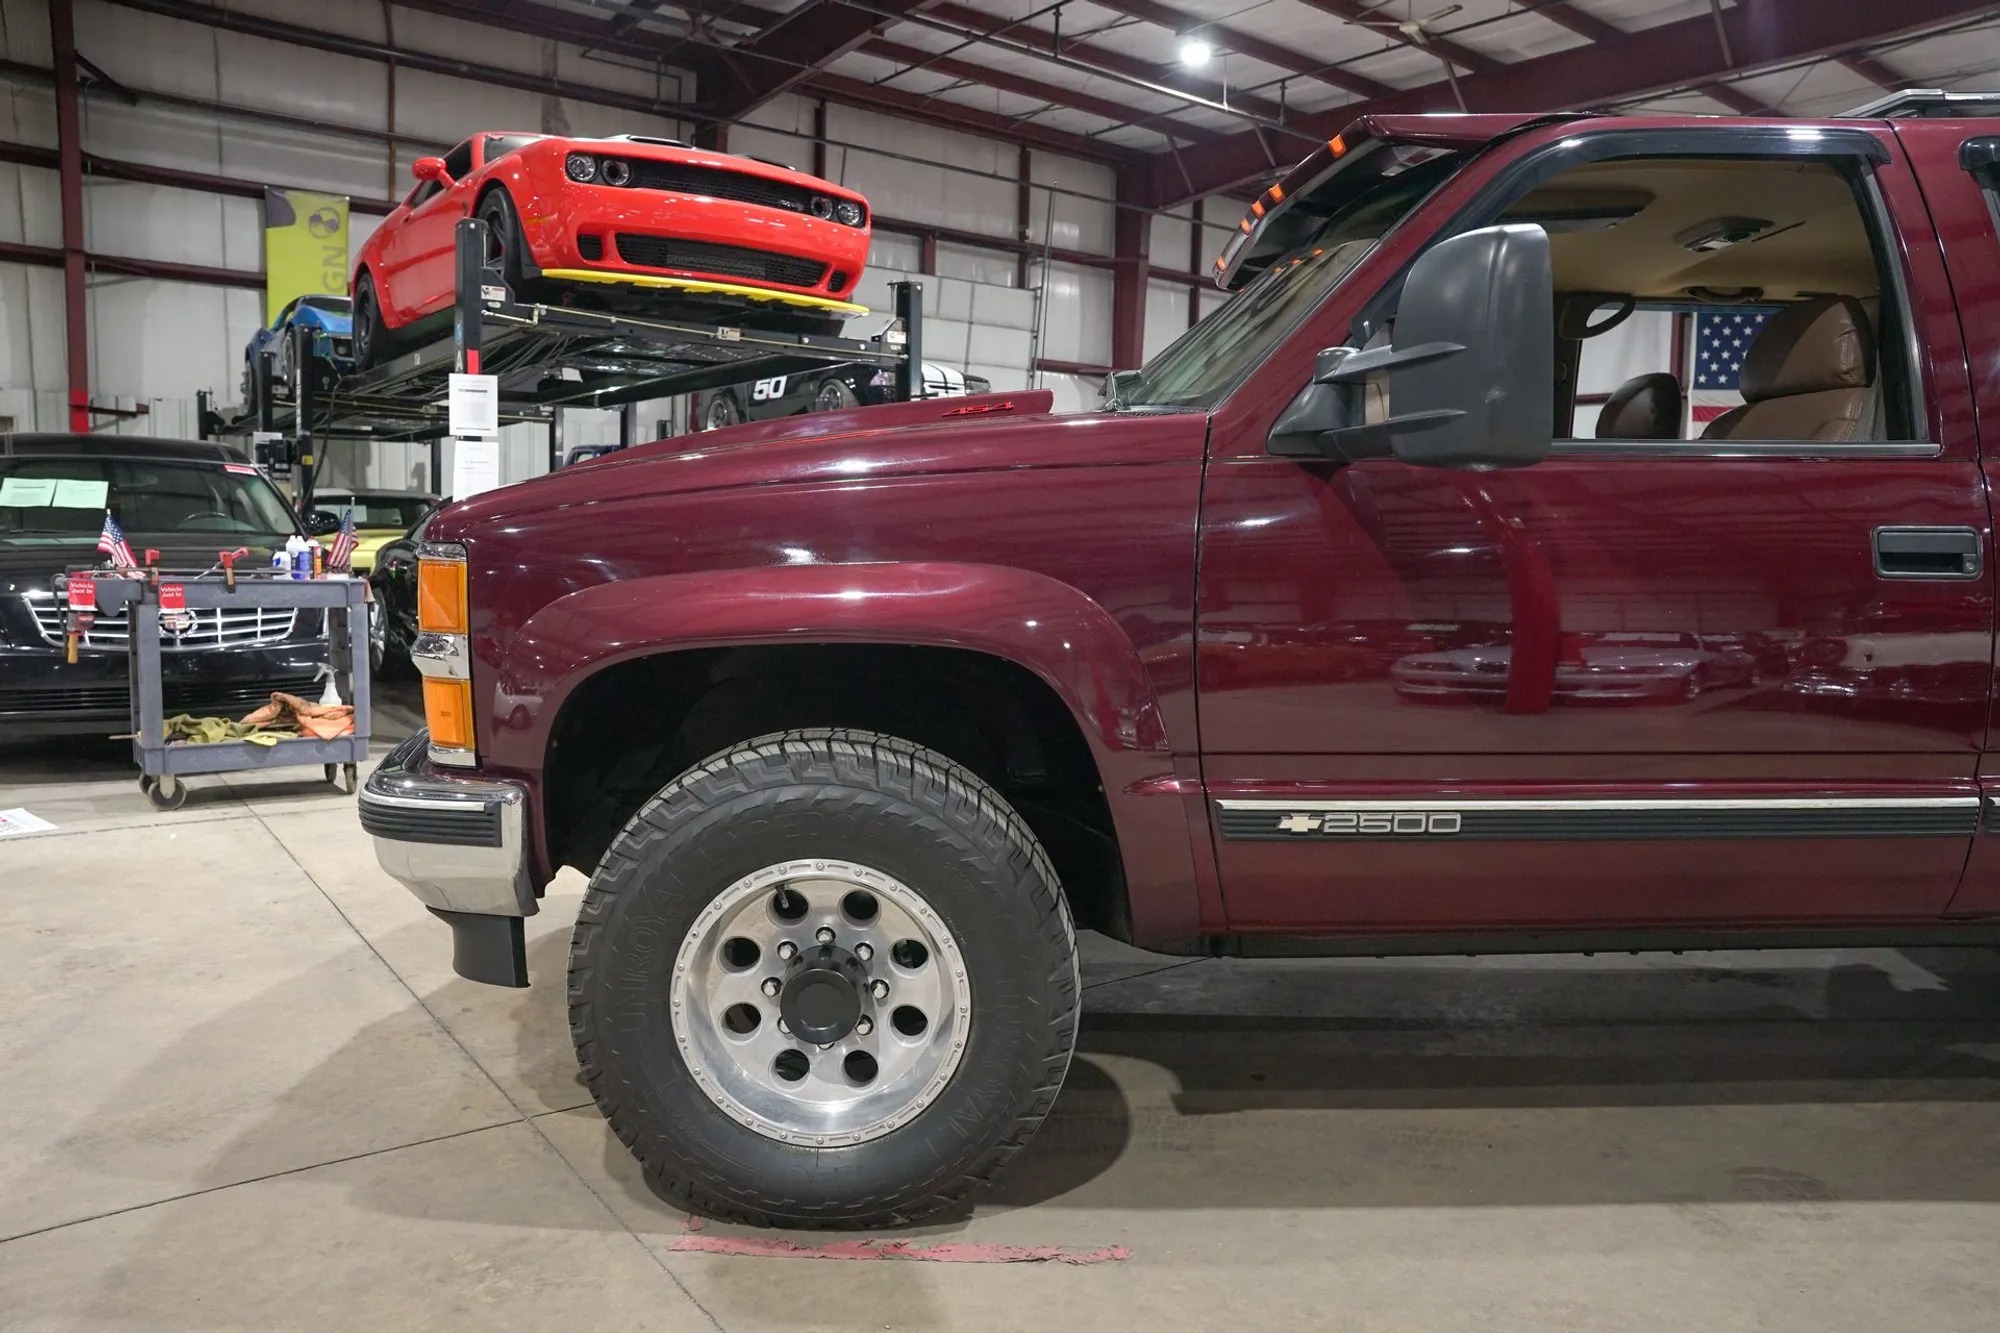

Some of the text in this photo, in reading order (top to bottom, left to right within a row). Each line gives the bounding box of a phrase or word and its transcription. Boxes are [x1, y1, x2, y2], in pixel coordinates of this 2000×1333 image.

[753, 375, 787, 401] 50
[1322, 811, 1462, 834] 2500
[618, 866, 696, 1033] UNIROYAL
